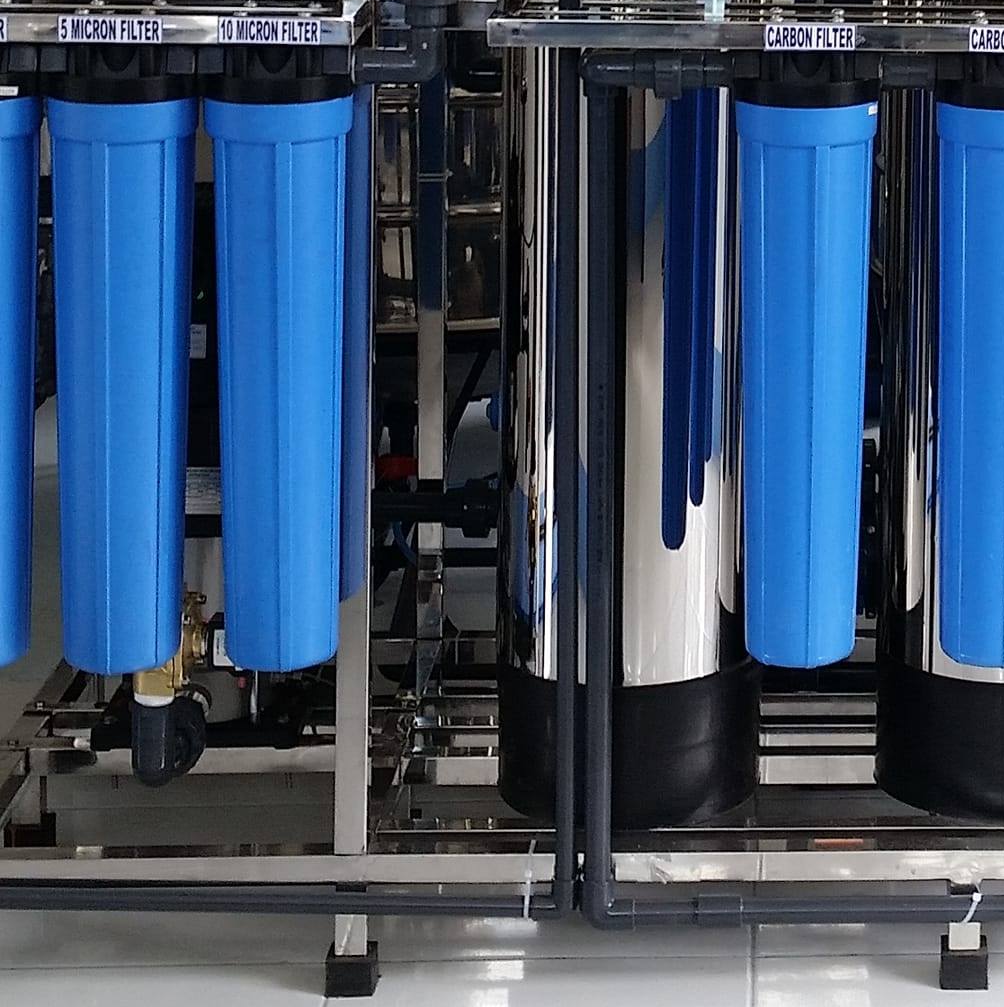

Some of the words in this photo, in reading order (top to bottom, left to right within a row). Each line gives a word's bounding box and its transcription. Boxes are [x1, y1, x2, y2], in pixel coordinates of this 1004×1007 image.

[60, 18, 68, 40] 5
[71, 18, 117, 40] MICRON
[120, 19, 160, 41] FILTER
[220, 18, 234, 41] 10
[236, 19, 279, 42] MICRON
[281, 20, 319, 42] FILTER
[767, 26, 813, 49] CARBON
[816, 27, 854, 49] FILTER
